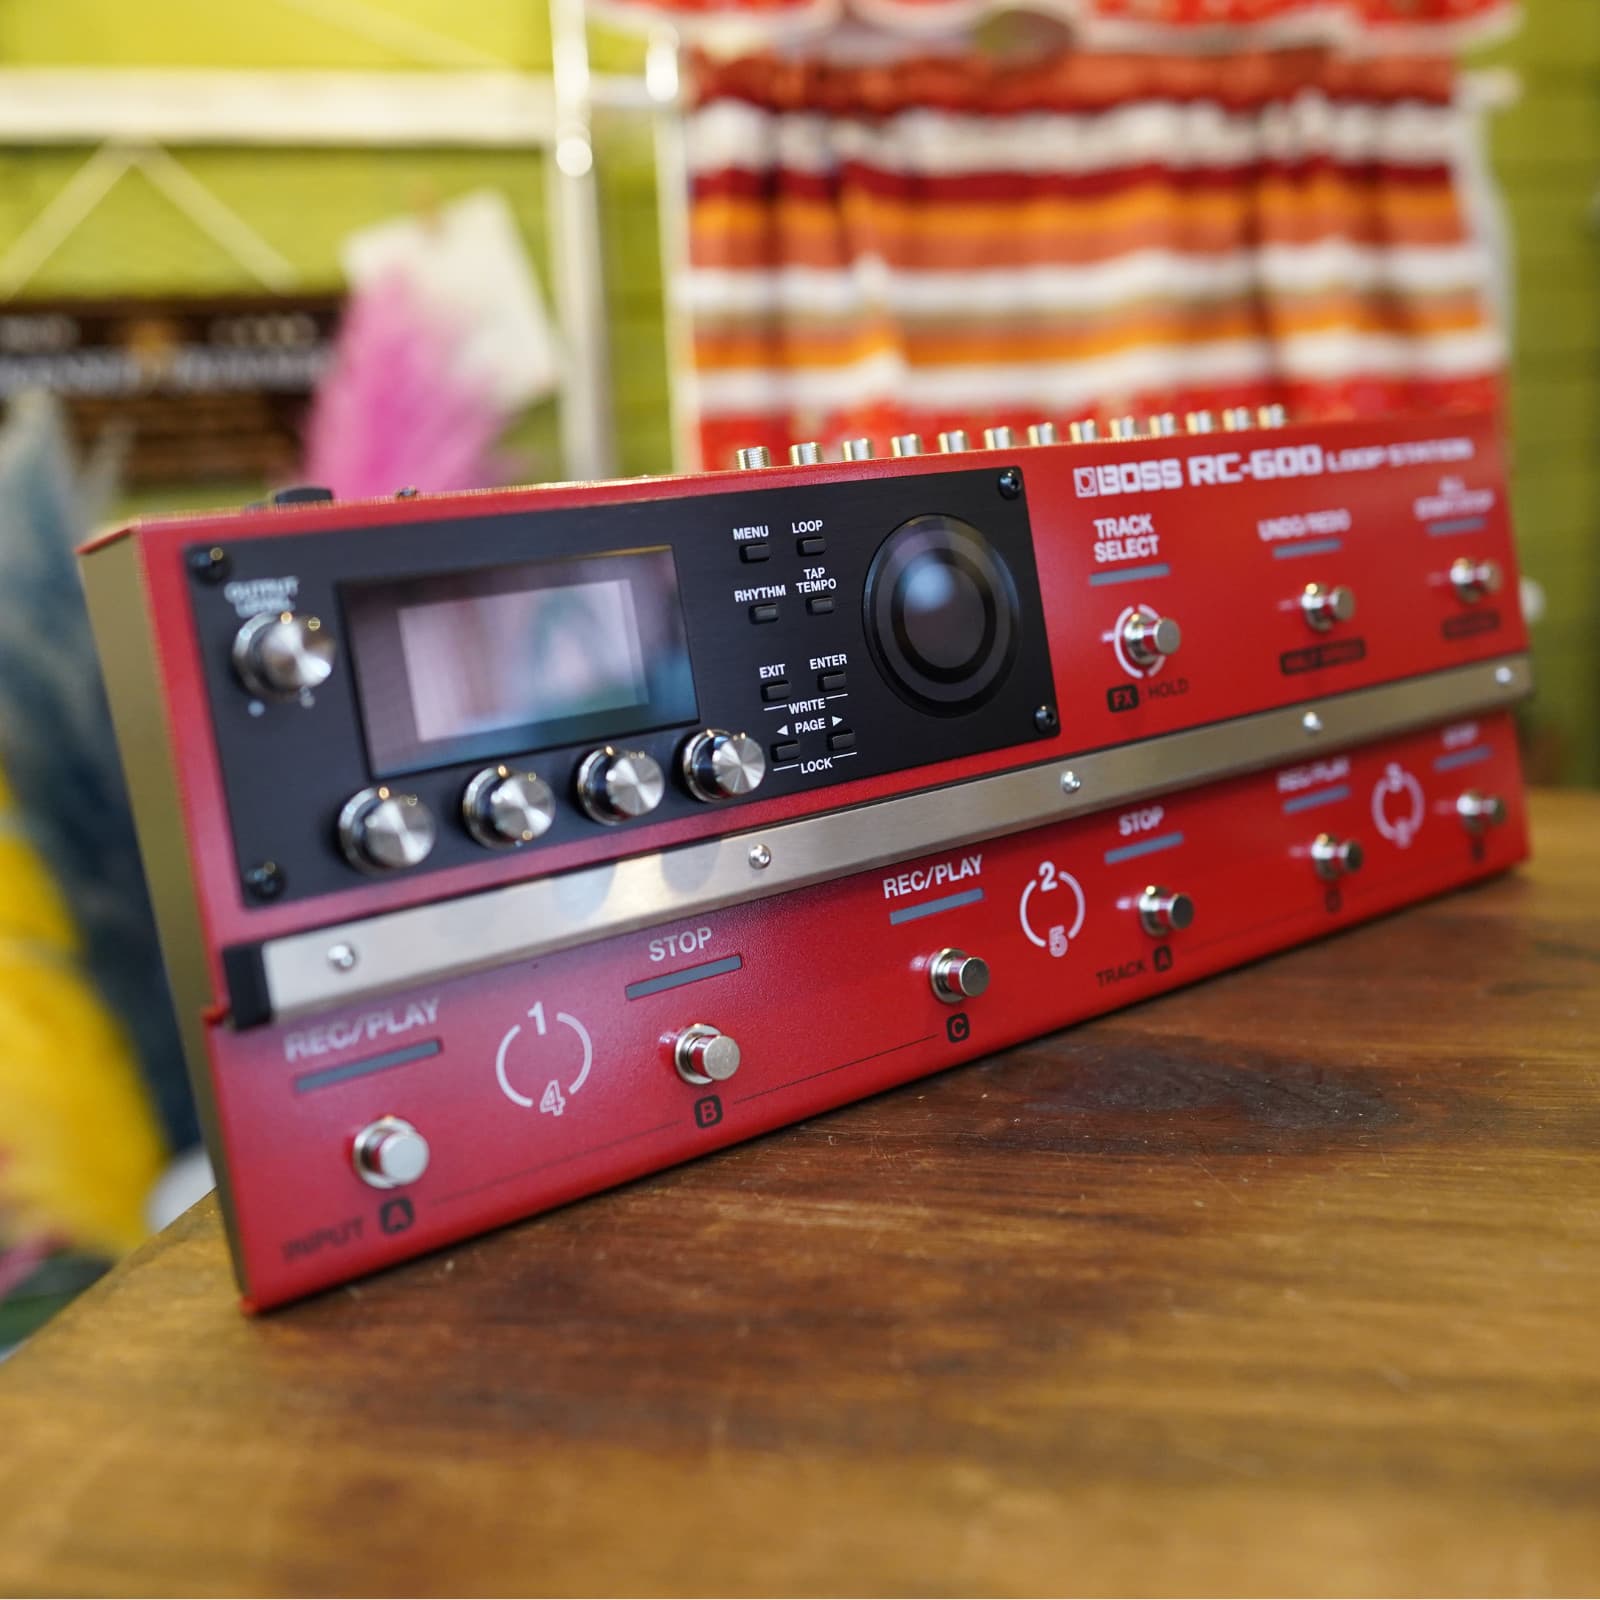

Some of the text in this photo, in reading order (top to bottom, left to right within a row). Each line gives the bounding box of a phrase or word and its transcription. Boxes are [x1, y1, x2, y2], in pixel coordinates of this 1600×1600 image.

[1097, 459, 1182, 495] BOSS
[1188, 446, 1322, 485] RC-600
[732, 525, 770, 541] MENU
[791, 519, 824, 535] LOOP
[1093, 513, 1154, 540] TRACK
[1093, 534, 1160, 563] SELECT
[796, 578, 837, 594] TEMPO
[803, 567, 826, 580] TAP
[734, 584, 787, 602] RHYTHM
[759, 663, 786, 679] EXIT
[809, 653, 848, 670] ENTER
[1148, 678, 1189, 699] HOLD
[788, 698, 826, 715] WRITE
[795, 718, 826, 734] PAGE
[800, 757, 833, 774] LOCK
[1118, 805, 1165, 837] STOP
[882, 854, 984, 900] REC/PLAY
[1038, 860, 1057, 891] 2
[648, 927, 713, 962] STOP
[1049, 925, 1068, 958] 5
[1095, 957, 1147, 988] TRACK
[285, 999, 440, 1062] REC/PLAY
[528, 1001, 547, 1036] 1
[539, 1080, 566, 1116] 4
